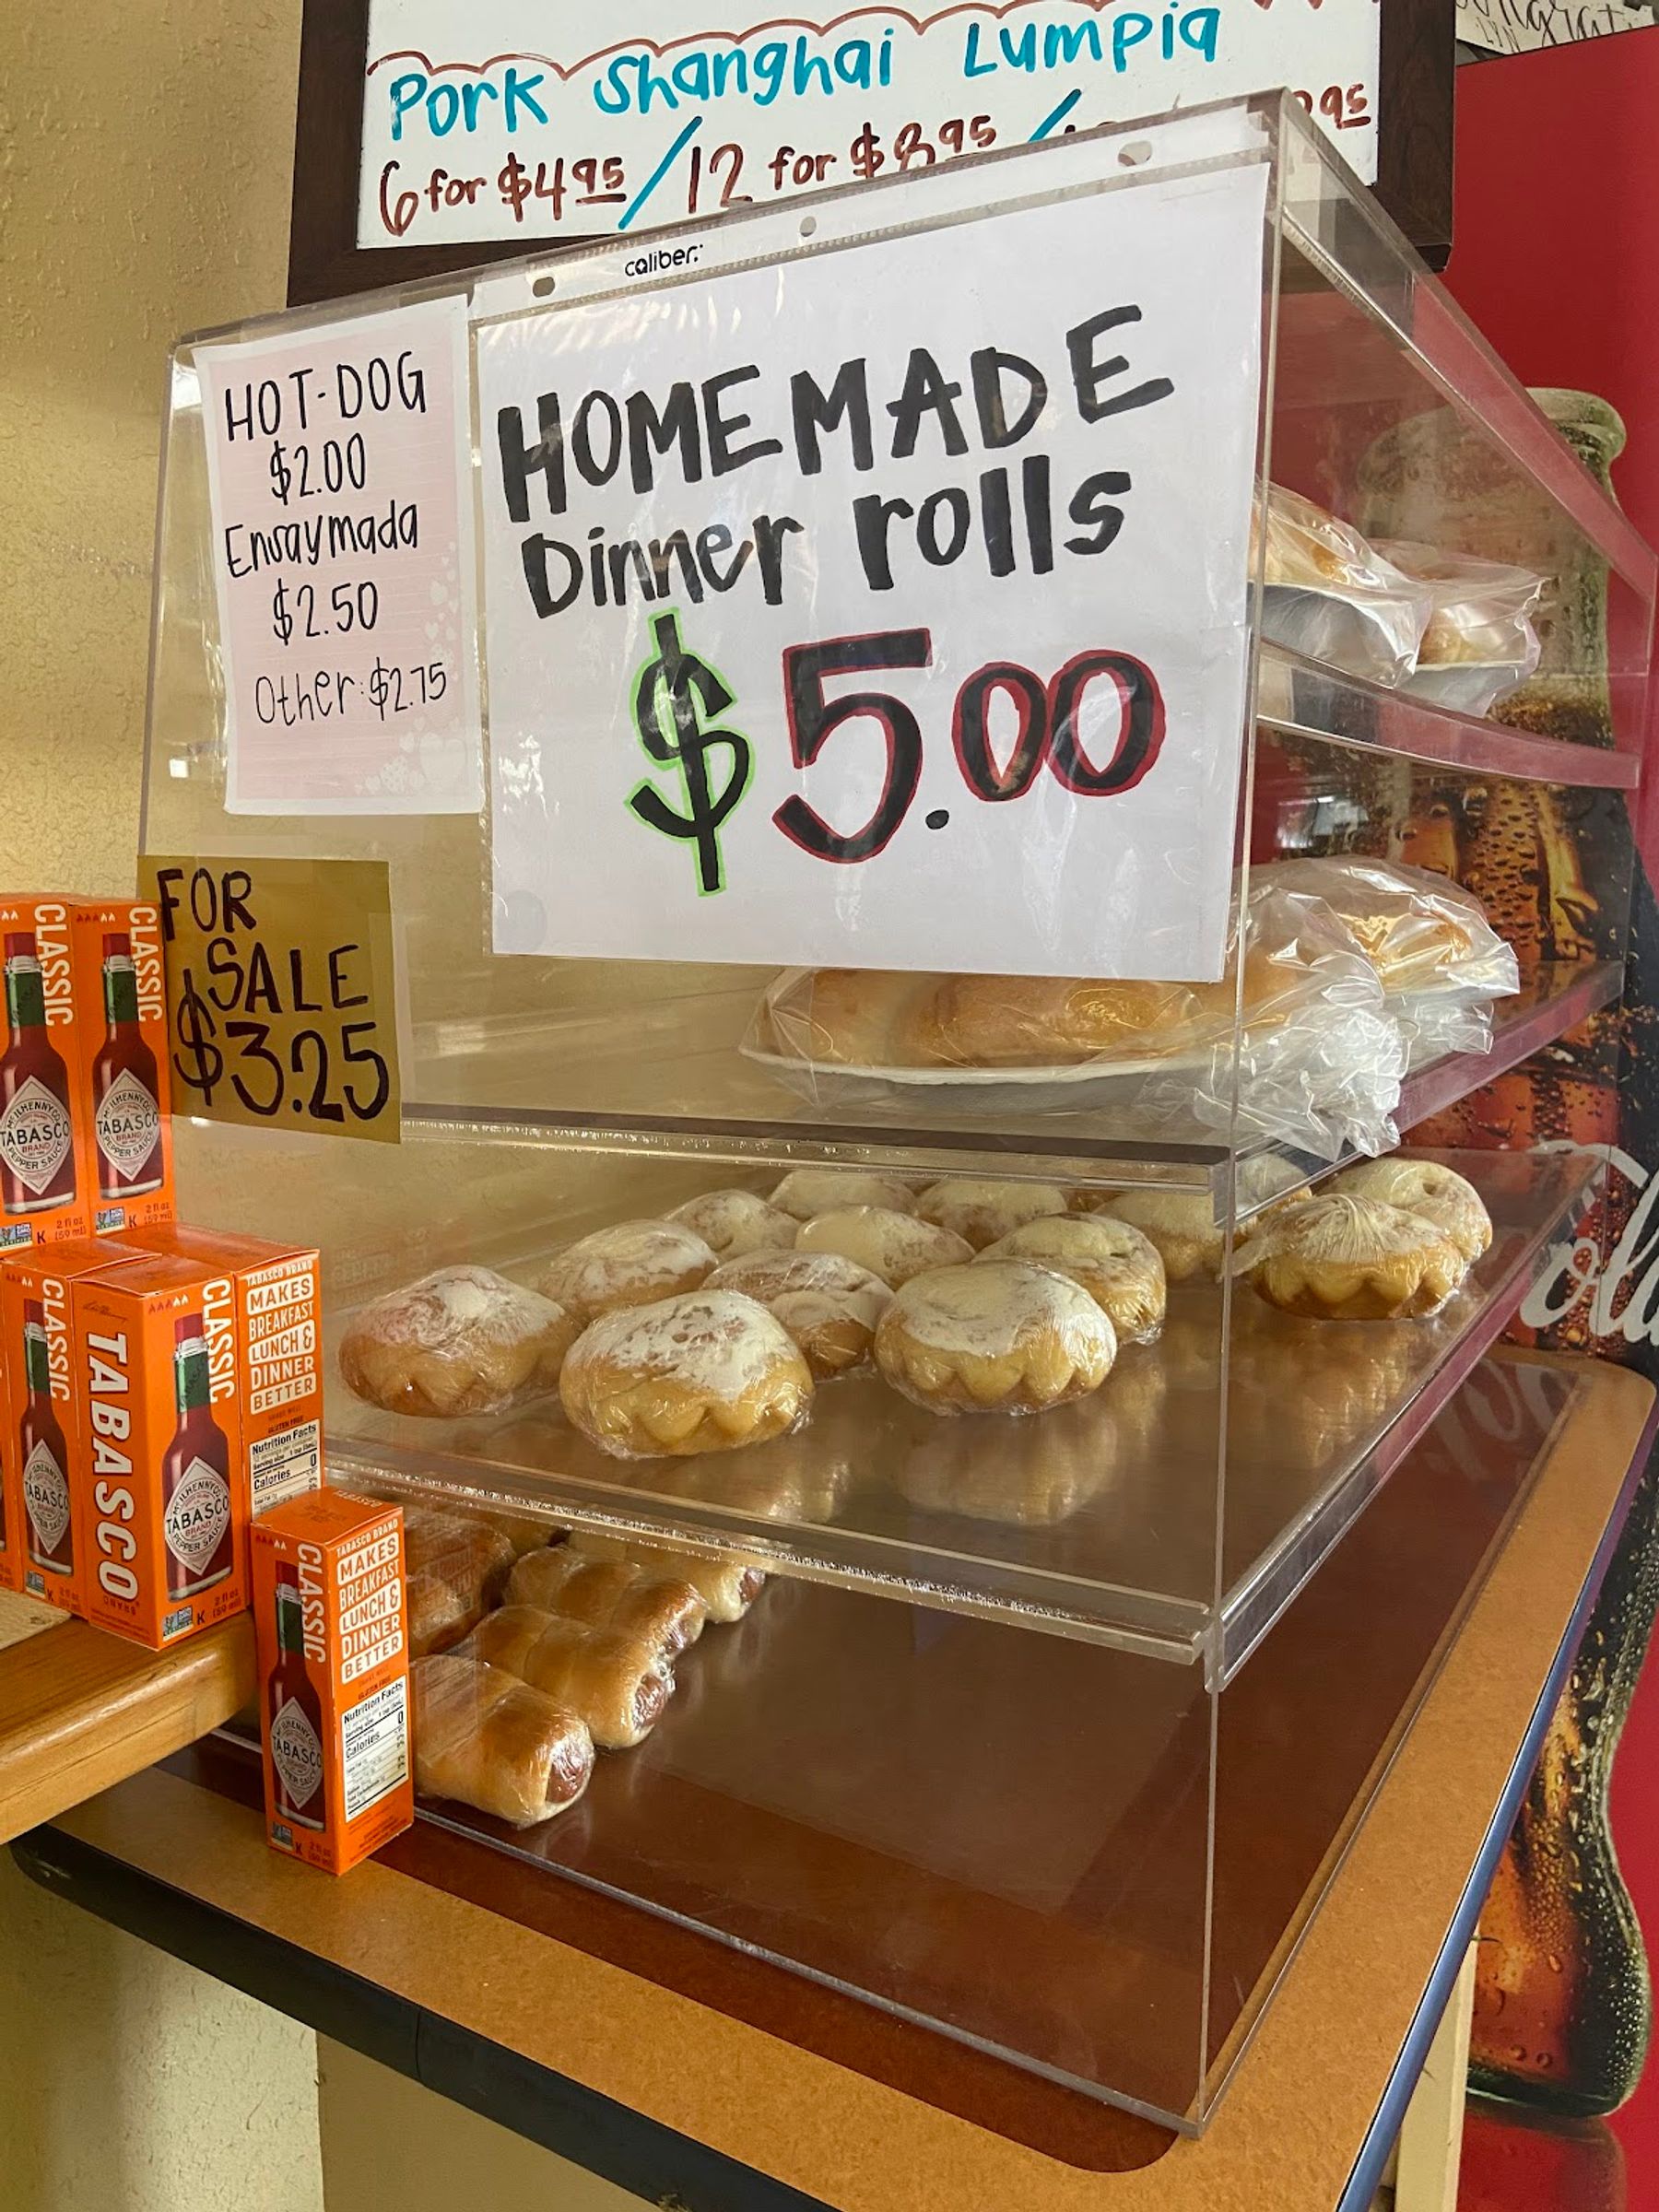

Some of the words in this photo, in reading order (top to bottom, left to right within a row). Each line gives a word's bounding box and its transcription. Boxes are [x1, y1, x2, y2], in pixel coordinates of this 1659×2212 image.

[390, 67, 548, 141] Pork
[594, 29, 894, 114] Shanghai
[964, 1, 1220, 77] Lumpia
[380, 160, 418, 236] 6
[424, 168, 487, 212] for
[688, 144, 753, 214] 12
[769, 147, 837, 190] for
[225, 351, 427, 441] HOT-DOG
[497, 304, 1174, 524] HOMEMADE
[270, 432, 366, 505] $2.00
[225, 500, 418, 578] Ensaymada
[521, 514, 805, 618] Dinner
[853, 455, 1132, 592] rolls
[273, 578, 378, 646] $2.50
[623, 607, 1167, 897] $5.00
[158, 867, 257, 941] FOR
[34, 904, 74, 1026] CLASSIC
[128, 907, 163, 1022] CLASSIC
[206, 937, 369, 1014] SALE
[173, 969, 389, 1123] $3.25
[0, 1121, 70, 1147] TABASCO
[97, 1111, 159, 1135] TABASCO
[9, 1147, 39, 1170] PEPPER
[41, 1140, 63, 1167] SAUCE
[37, 1231, 45, 1244] K
[250, 1278, 311, 1312] MAKES
[42, 1278, 71, 1402] CLASSIC
[202, 1279, 235, 1404] CLASSIC
[248, 1300, 314, 1342] BREAKFAST
[252, 1330, 300, 1361] LUNCH
[302, 1326, 312, 1350] &
[251, 1356, 314, 1391] DINNER
[253, 1378, 313, 1411] BETTER
[253, 1433, 291, 1454] Nutrition
[293, 1424, 316, 1440] Facts
[88, 1333, 138, 1601] TABASCO
[254, 1468, 290, 1489] Calories
[166, 1495, 229, 1535] TABASCO
[335, 1531, 371, 1558] TABASCO
[373, 1518, 398, 1537] BRAND
[340, 1537, 396, 1582] MAKES
[297, 1543, 326, 1664] CLASSIC
[339, 1559, 399, 1612] BREAKFAST
[342, 1597, 385, 1630] LUNCH
[389, 1584, 399, 1609] &
[341, 1613, 400, 1660] DINNER
[345, 1636, 399, 1679] BETTER
[344, 1695, 381, 1724] Nutrition
[381, 1681, 404, 1701] Facts
[272, 1735, 322, 1768] TABASCO
[346, 1732, 380, 1759] Calories
[397, 1711, 404, 1724] 0
